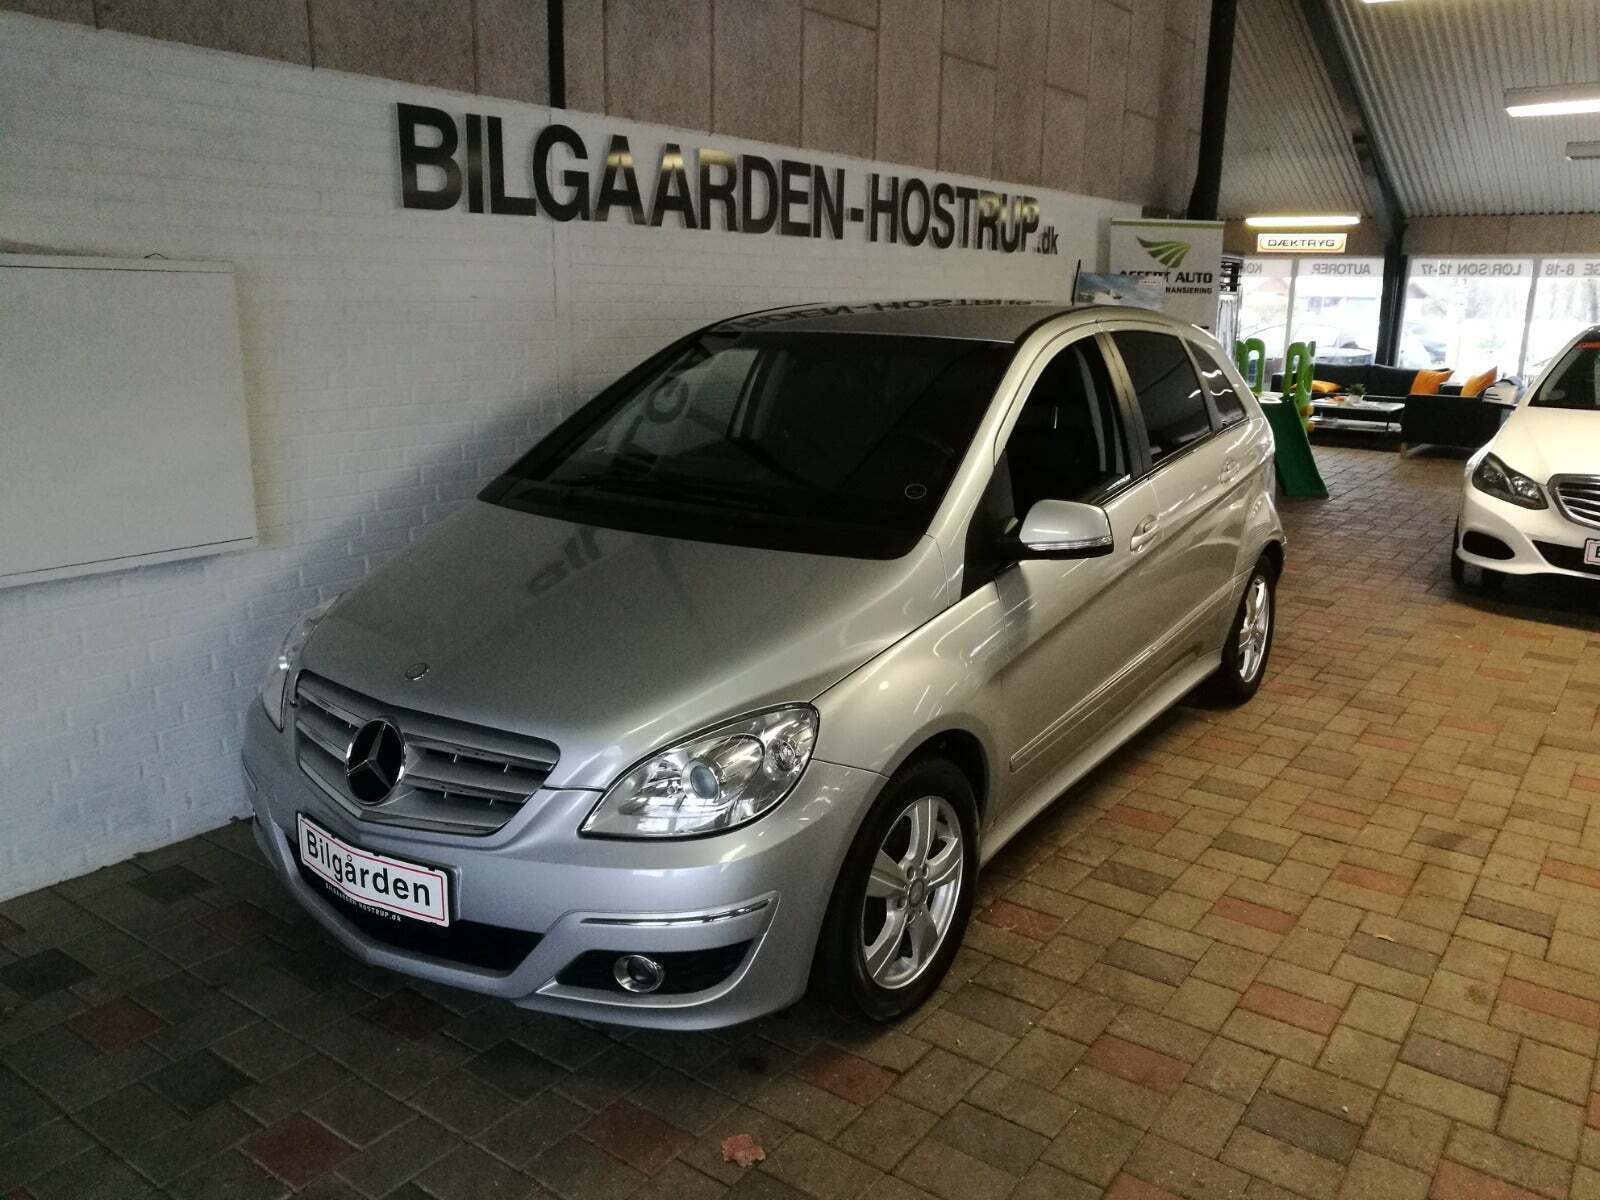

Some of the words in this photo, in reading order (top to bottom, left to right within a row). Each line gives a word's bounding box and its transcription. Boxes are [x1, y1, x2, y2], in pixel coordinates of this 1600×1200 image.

[1267, 239, 1335, 247] DÆKTRYG
[1175, 271, 1213, 283] AUTO
[1165, 286, 1213, 294] NANSIERING
[306, 828, 431, 907] Bilgården
